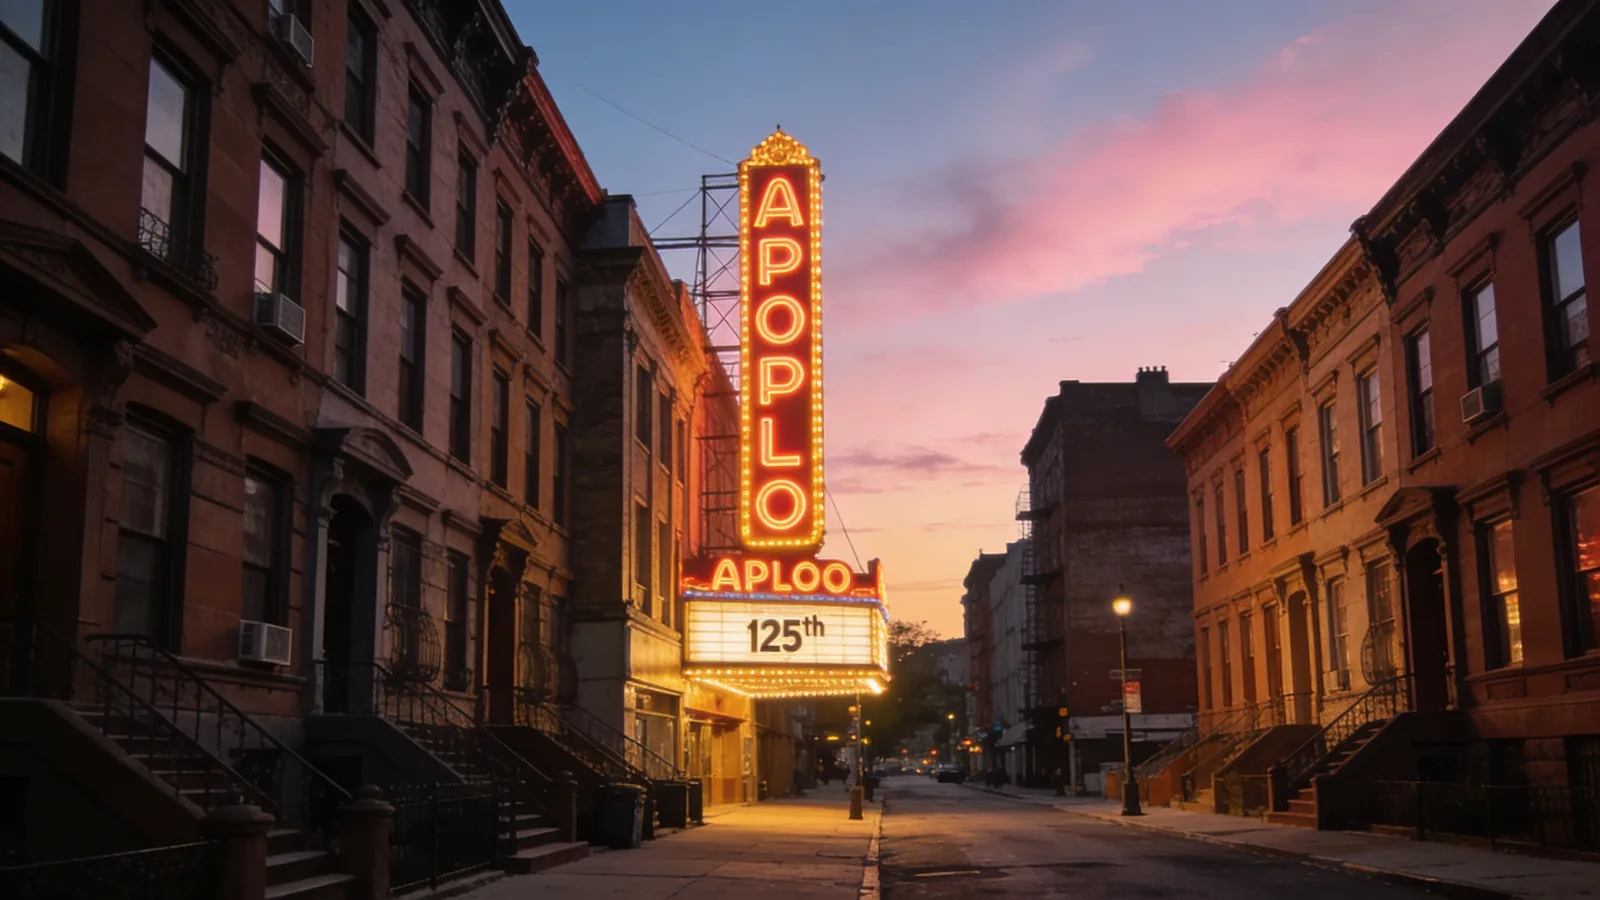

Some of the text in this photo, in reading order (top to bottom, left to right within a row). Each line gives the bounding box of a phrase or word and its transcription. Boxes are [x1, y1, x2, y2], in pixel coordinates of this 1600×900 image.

[753, 177, 807, 531] APOPLO
[711, 557, 852, 594] APLOO
[747, 614, 825, 653] 125th
